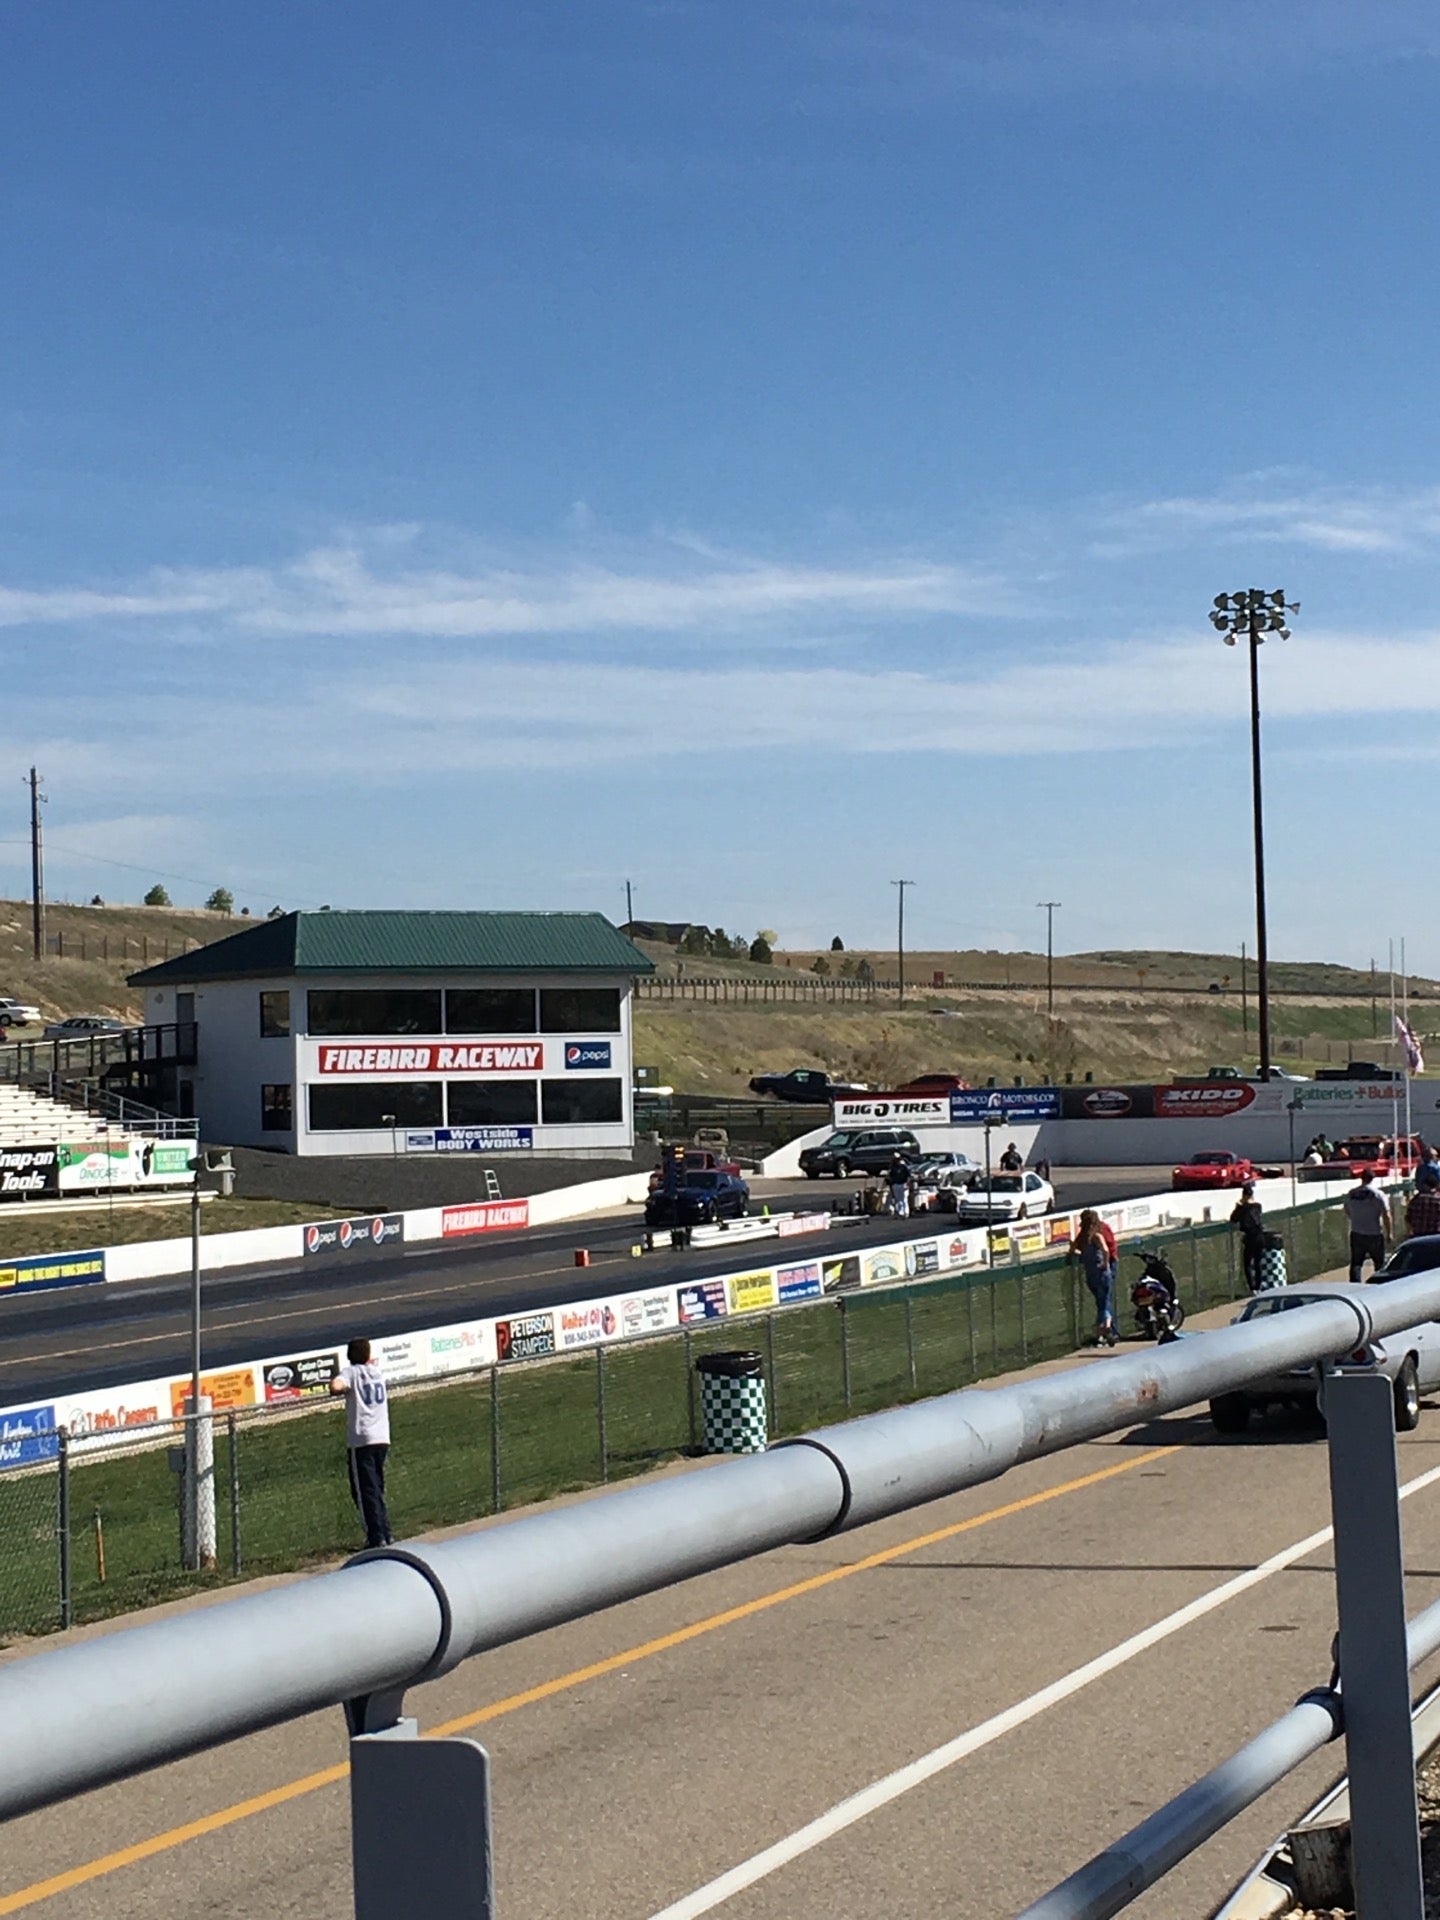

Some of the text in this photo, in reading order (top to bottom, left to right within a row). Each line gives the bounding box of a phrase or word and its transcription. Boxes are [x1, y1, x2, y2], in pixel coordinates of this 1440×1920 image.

[324, 1046, 541, 1071] FIREBIRD RACEWAY
[581, 1051, 610, 1065] pepsi
[952, 1096, 987, 1105] BRONCO
[1169, 1088, 1244, 1101] KIDD
[1293, 1087, 1353, 1100] Batteries
[842, 1104, 872, 1115] BIG
[893, 1102, 942, 1114] TIRES
[450, 1129, 518, 1140] Westside
[437, 1140, 475, 1151] BODY
[478, 1137, 531, 1150] WORKS
[1, 1170, 47, 1191] Tools
[444, 1205, 529, 1232] FIREBIRD RACEWAY
[352, 1227, 370, 1240] pepsi
[384, 1223, 401, 1236] pepsi
[320, 1231, 337, 1244] pepsi
[561, 1311, 589, 1331] United
[589, 1307, 603, 1327] Oil
[510, 1314, 554, 1339] PETERSON
[510, 1332, 555, 1359] STAMPEDE
[86, 1406, 159, 1436] Little Caesars
